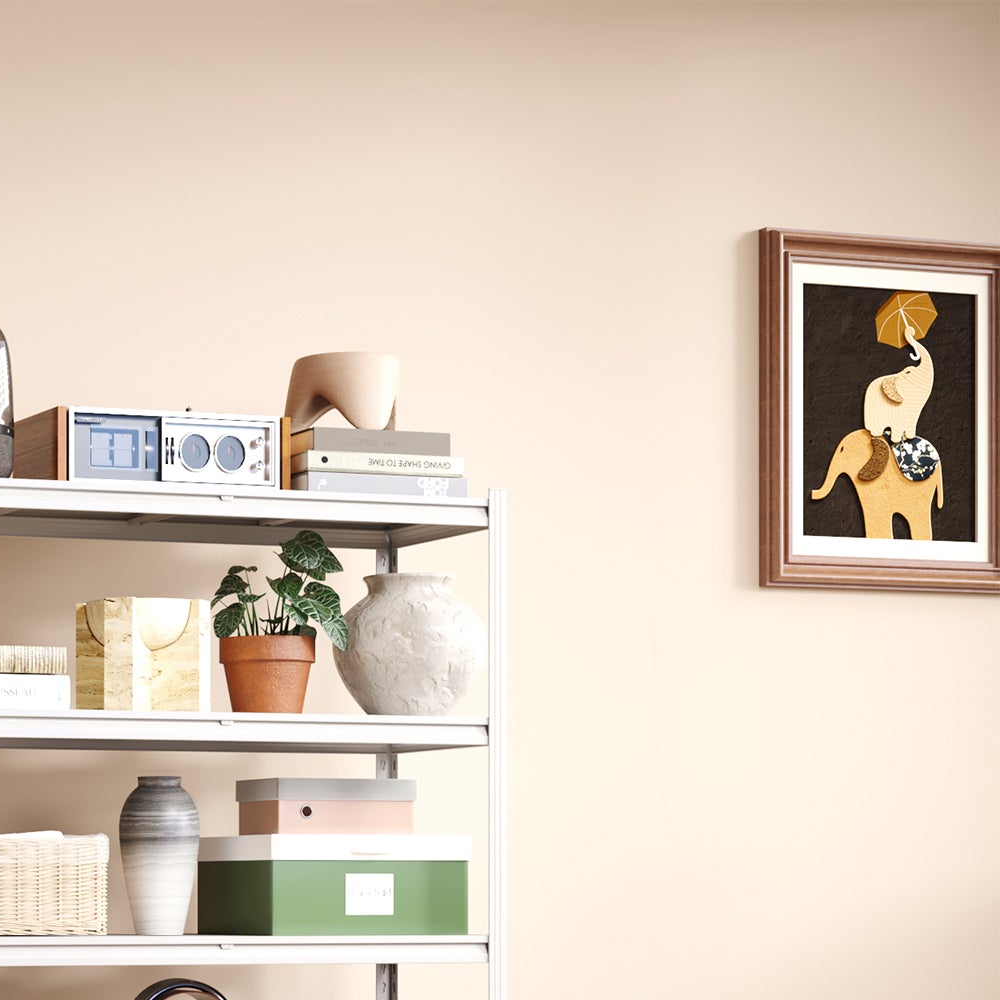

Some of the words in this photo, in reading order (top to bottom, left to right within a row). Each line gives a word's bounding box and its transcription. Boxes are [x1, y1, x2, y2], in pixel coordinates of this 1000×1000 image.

[368, 458, 385, 466] TIME
[386, 459, 397, 467] TO
[398, 460, 421, 468] SHAPE
[424, 460, 451, 470] GIVING
[417, 477, 449, 488] FORD
[423, 487, 449, 497] TOM
